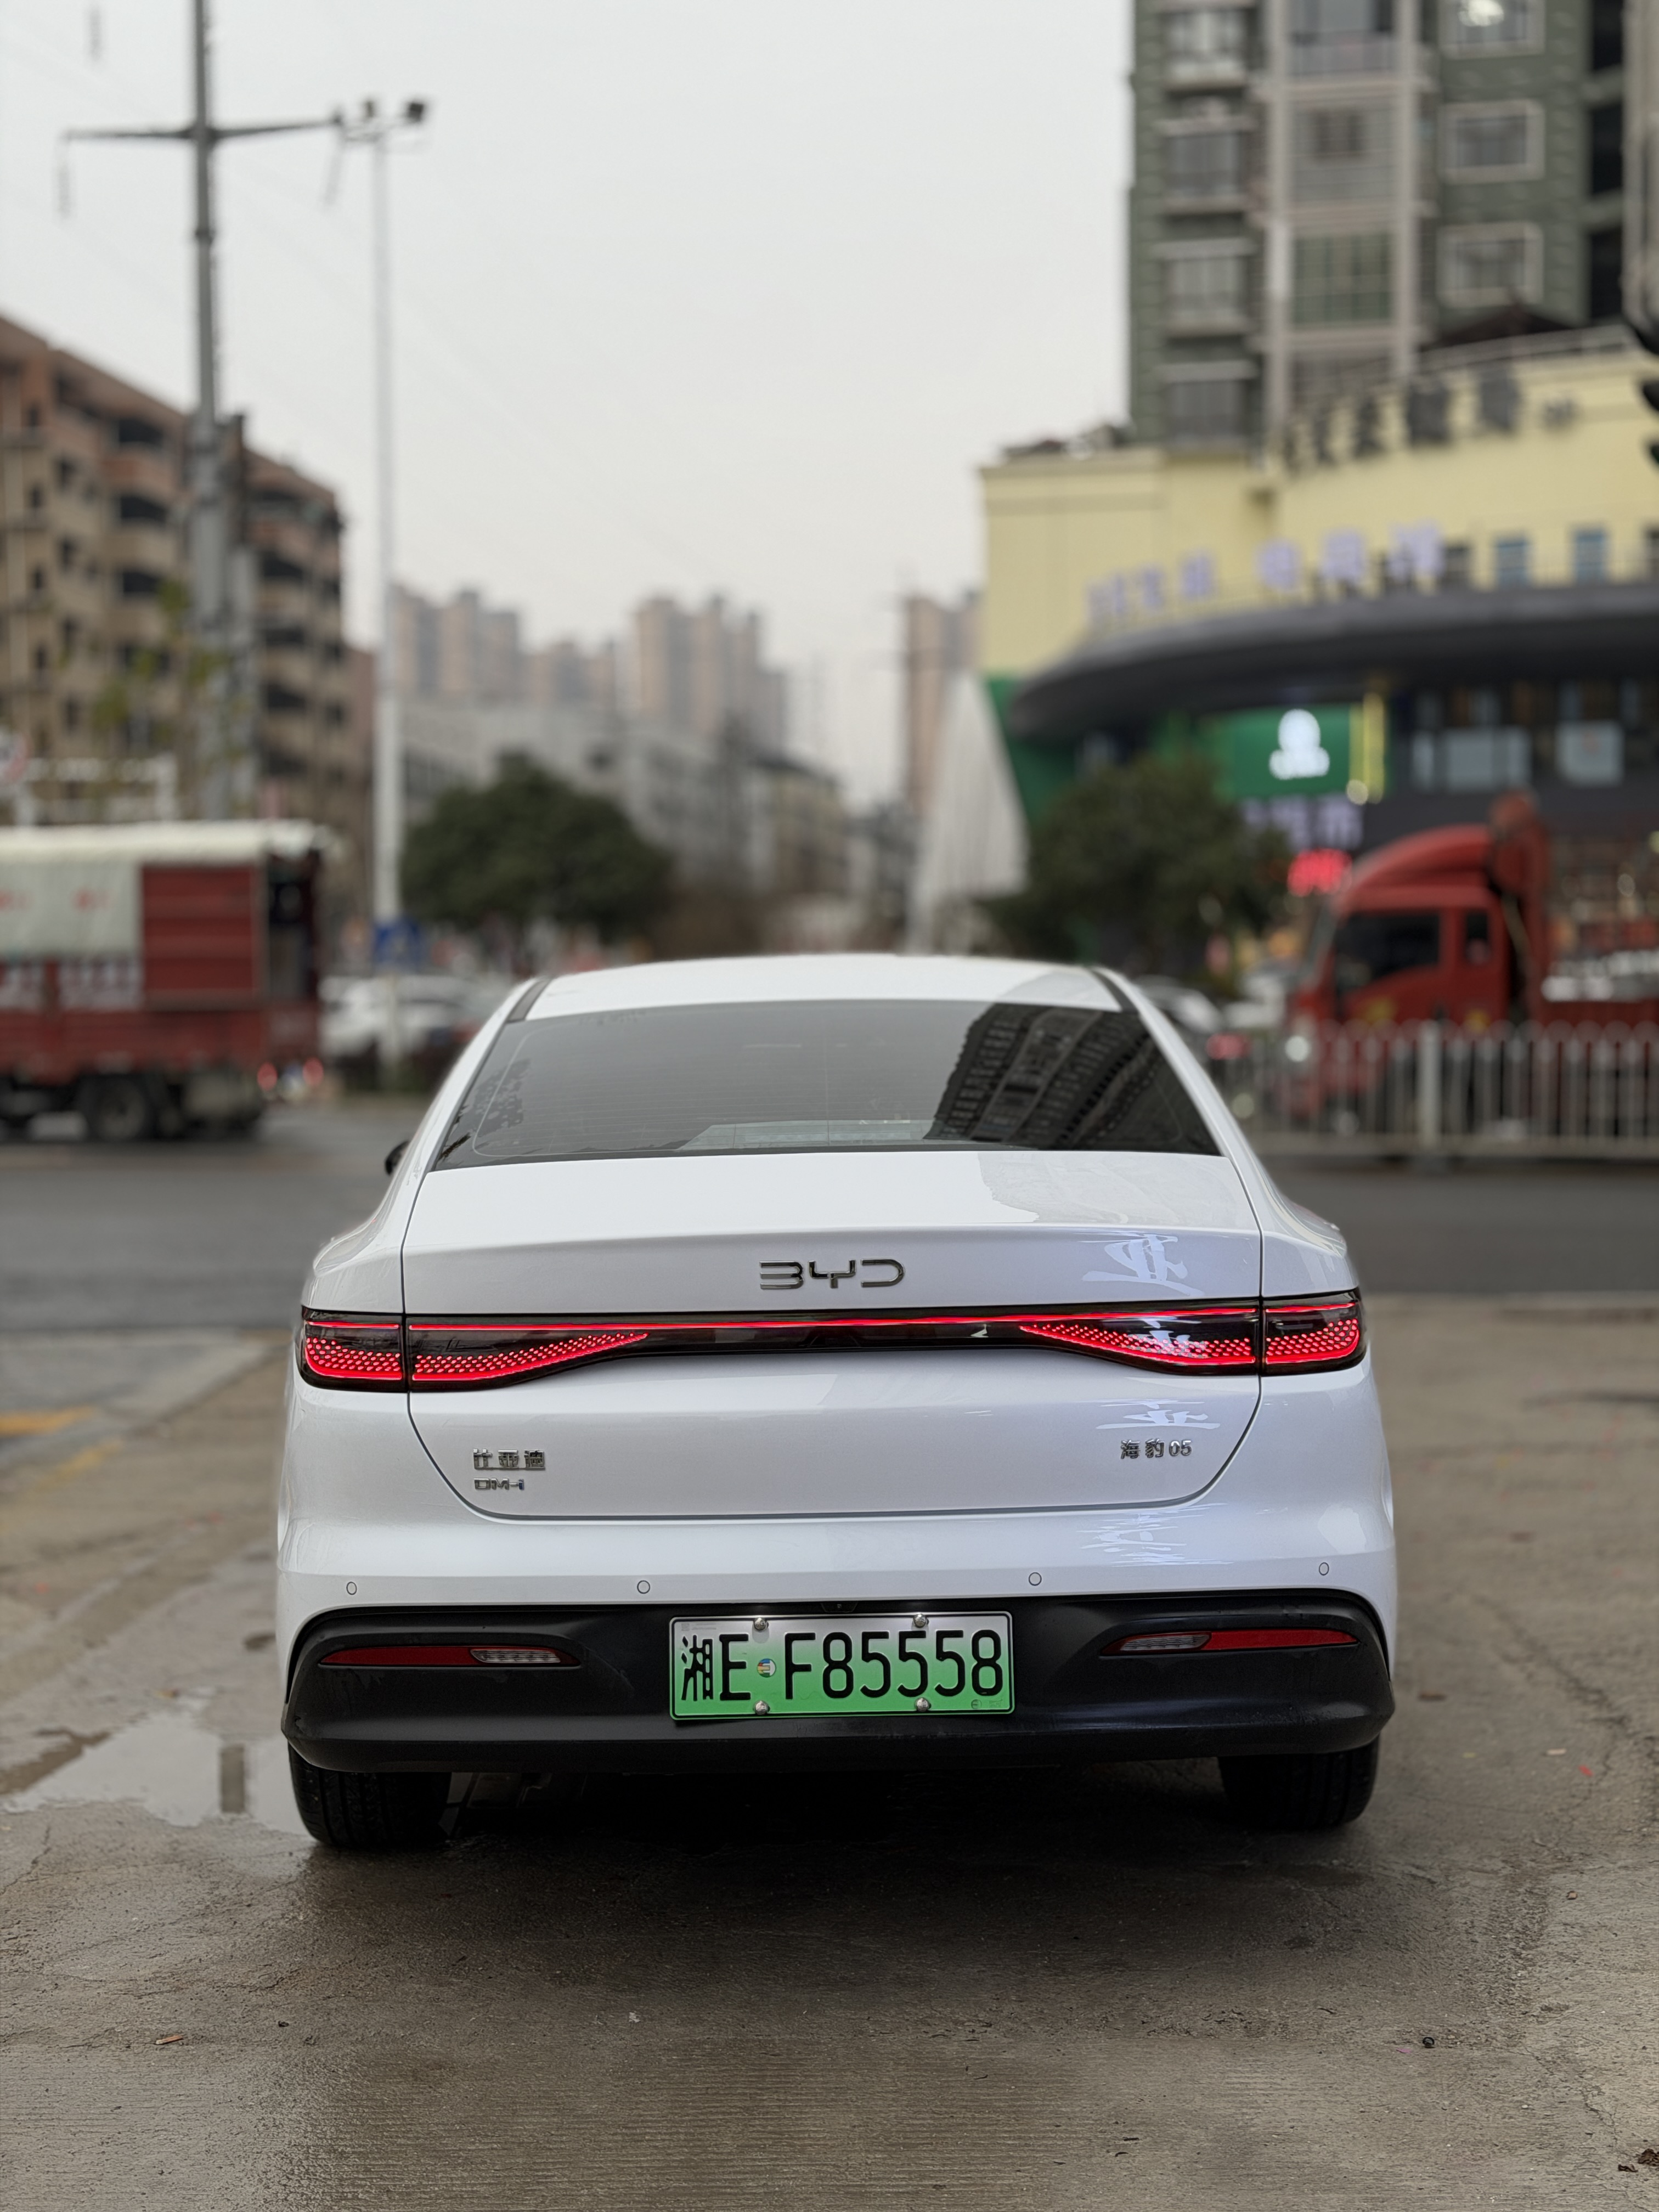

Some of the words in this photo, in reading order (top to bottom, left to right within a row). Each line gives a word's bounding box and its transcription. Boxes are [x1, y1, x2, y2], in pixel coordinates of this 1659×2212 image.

[759, 1259, 905, 1290] BYD
[473, 1448, 546, 1470] 比亚迪
